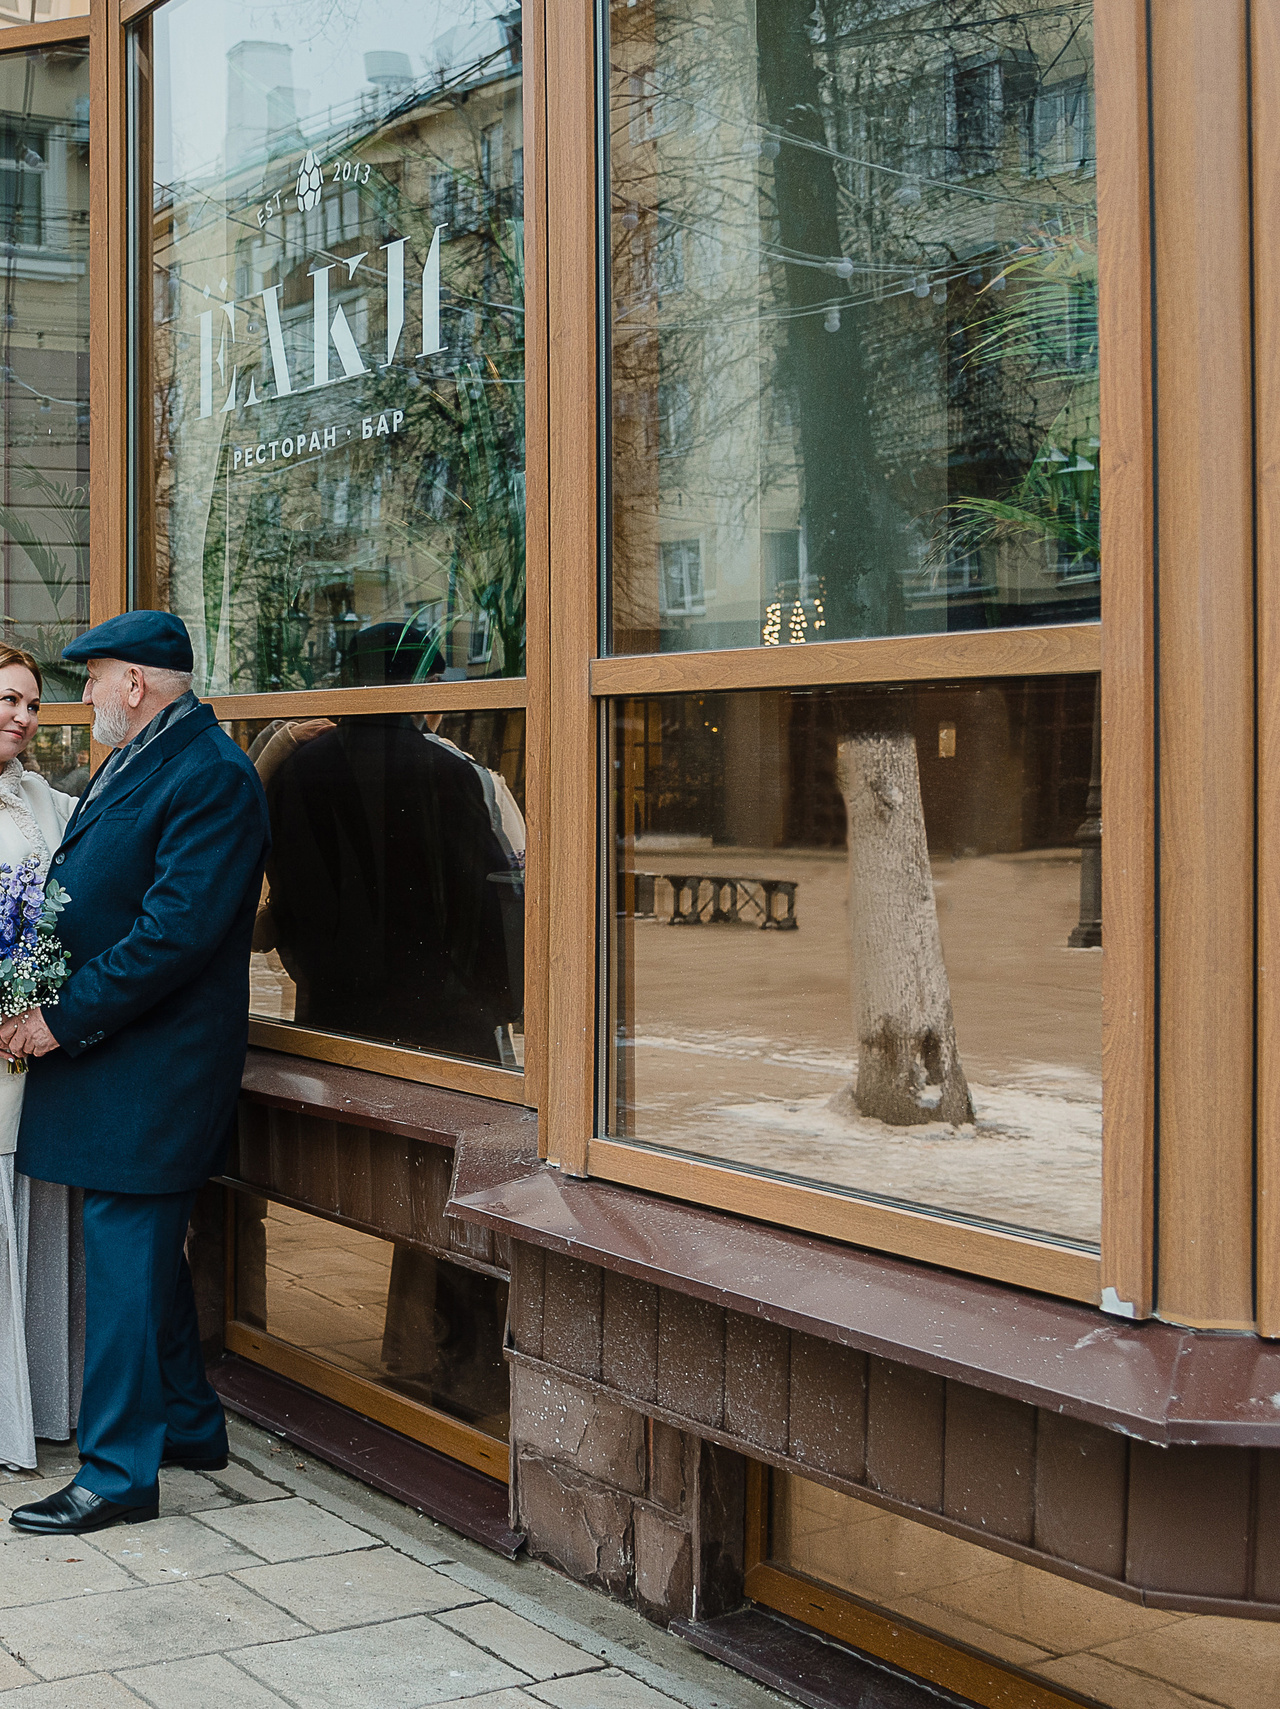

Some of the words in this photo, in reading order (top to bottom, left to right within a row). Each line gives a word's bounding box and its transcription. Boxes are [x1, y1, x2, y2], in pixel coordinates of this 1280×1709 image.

[255, 189, 289, 229] EST.
[332, 160, 372, 186] 2013
[194, 222, 450, 421] ЁЛКИ
[232, 426, 337, 470] РЕСТОРАН
[361, 409, 405, 441] БАР
